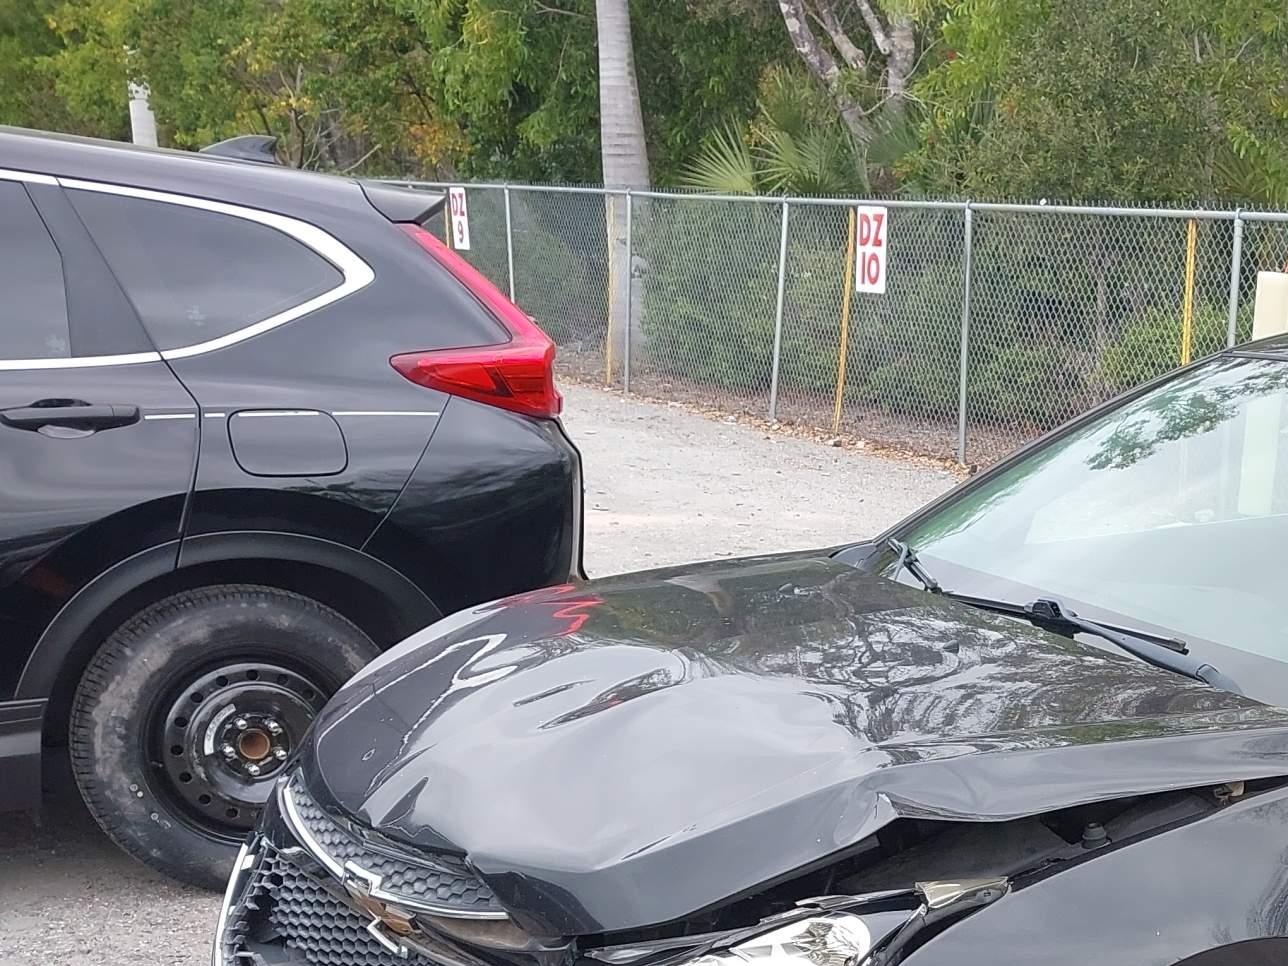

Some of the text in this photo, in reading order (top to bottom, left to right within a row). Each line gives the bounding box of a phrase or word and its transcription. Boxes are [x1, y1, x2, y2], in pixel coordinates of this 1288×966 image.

[451, 193, 465, 217] DZ
[859, 213, 885, 247] DZ
[860, 252, 881, 285] 10
